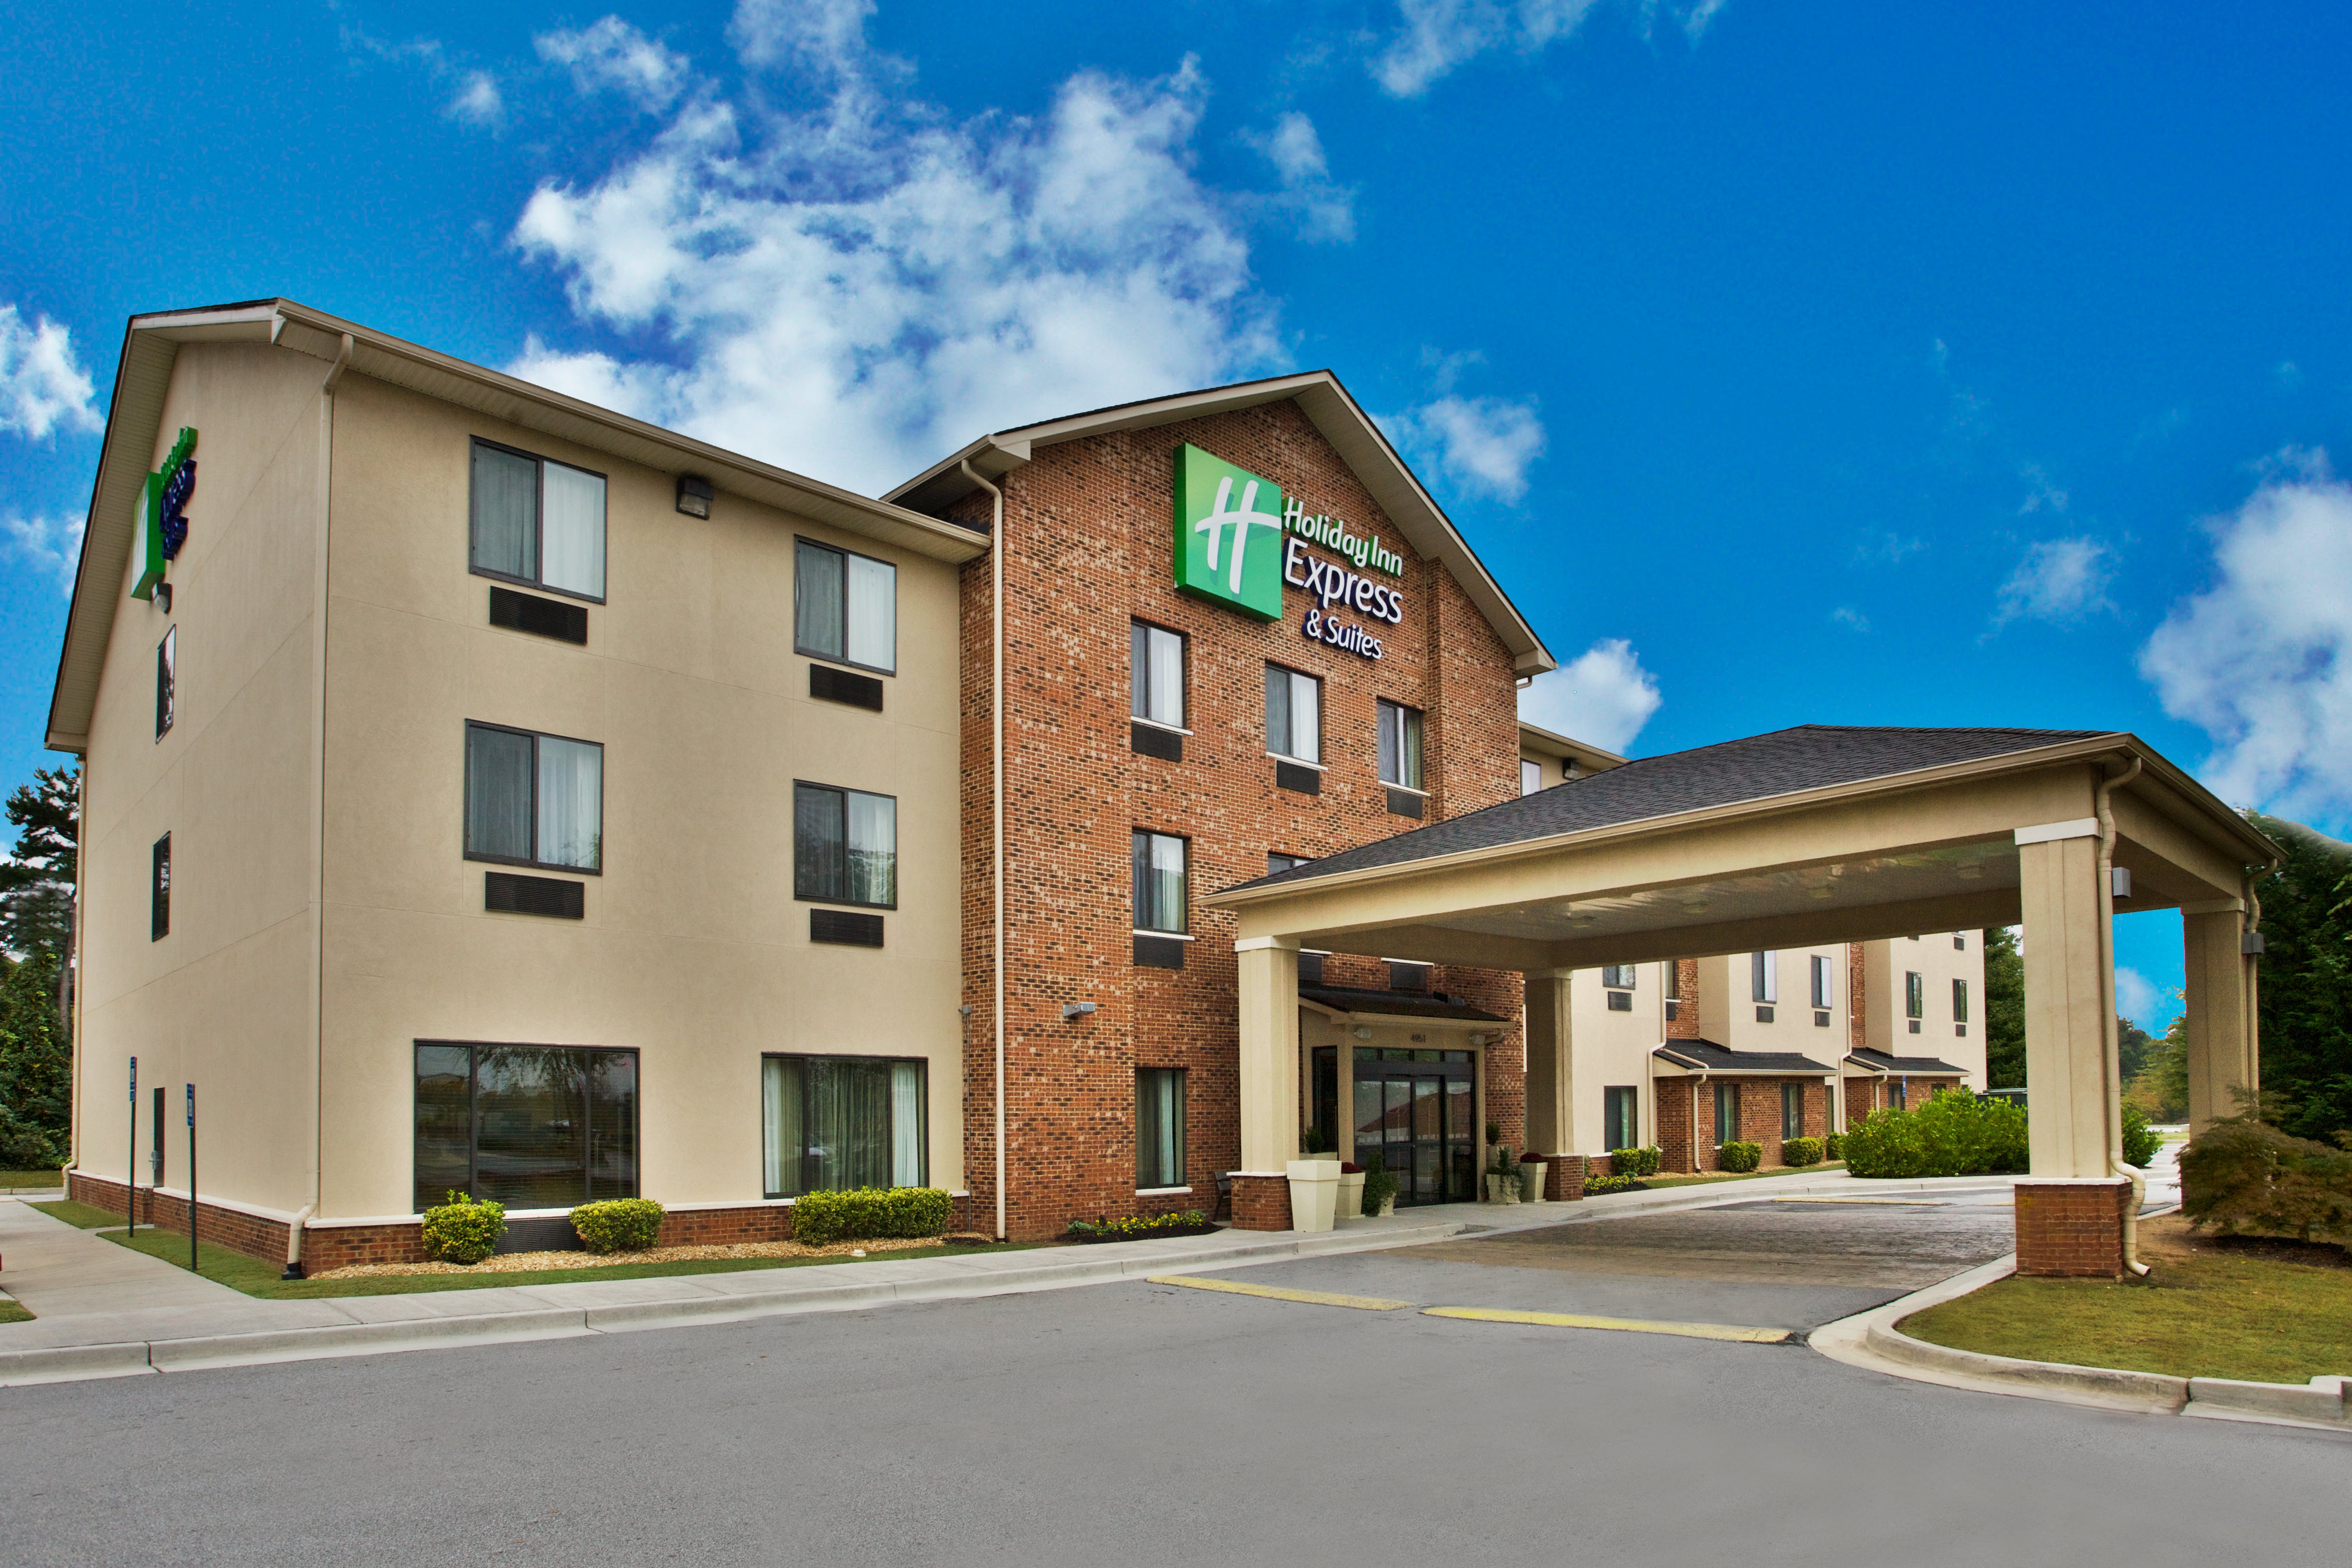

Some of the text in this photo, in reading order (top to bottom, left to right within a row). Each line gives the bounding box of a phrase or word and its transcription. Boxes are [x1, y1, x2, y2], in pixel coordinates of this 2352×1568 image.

[1284, 496, 1403, 576] Holiday Inn
[1285, 536, 1403, 623] Express
[1307, 609, 1382, 659] & Suites
